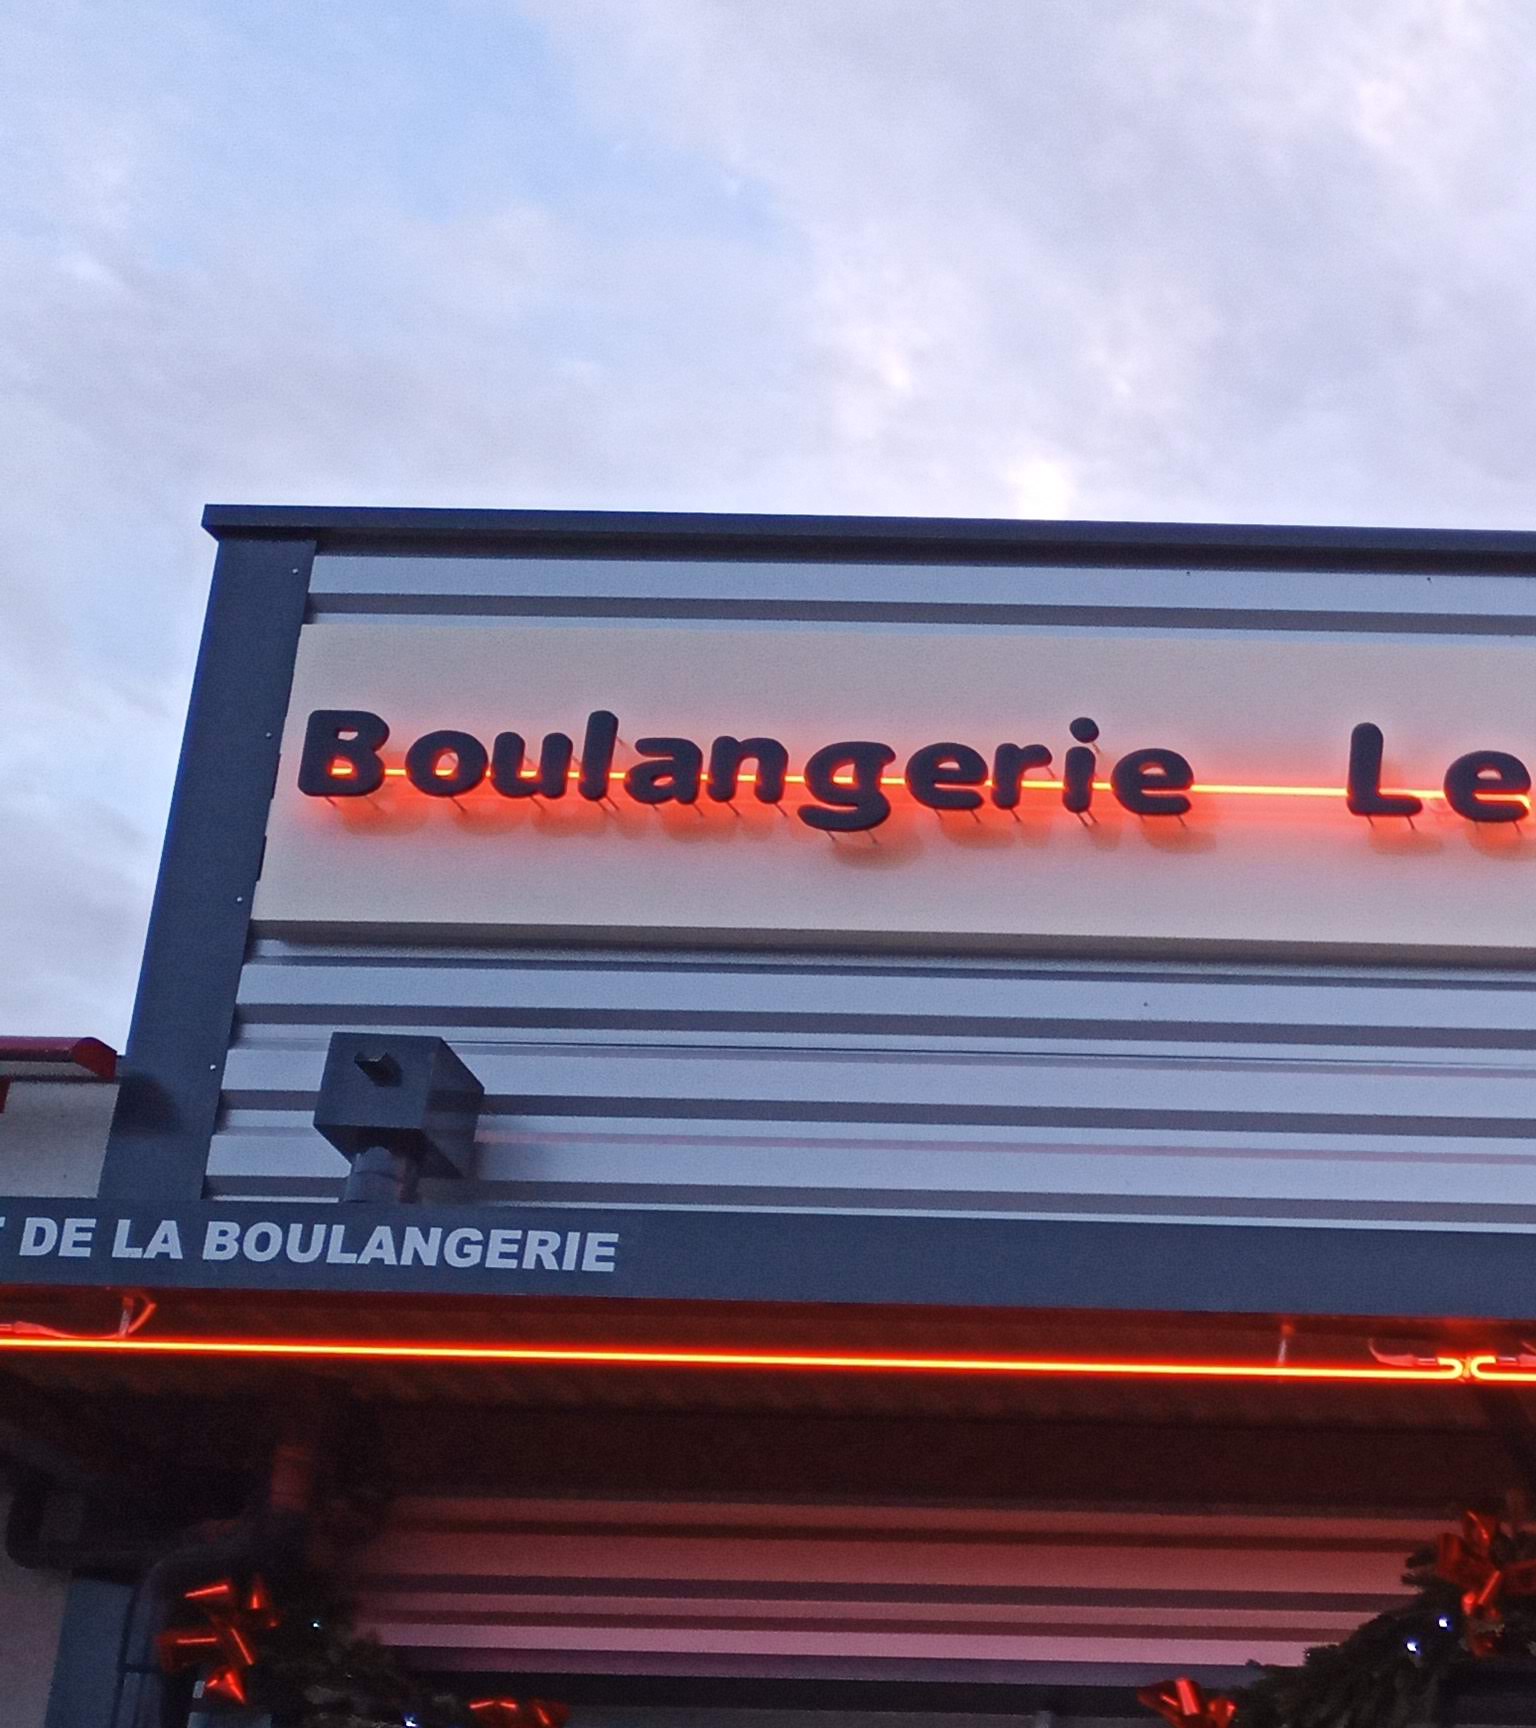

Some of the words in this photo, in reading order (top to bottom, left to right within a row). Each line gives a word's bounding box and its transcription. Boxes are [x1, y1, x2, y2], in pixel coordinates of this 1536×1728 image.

[296, 708, 1198, 832] Boulangerie
[1344, 721, 1533, 822] Le
[19, 1216, 97, 1258] DE
[111, 1218, 184, 1260] LA
[202, 1220, 620, 1273] BOULANGERIE
